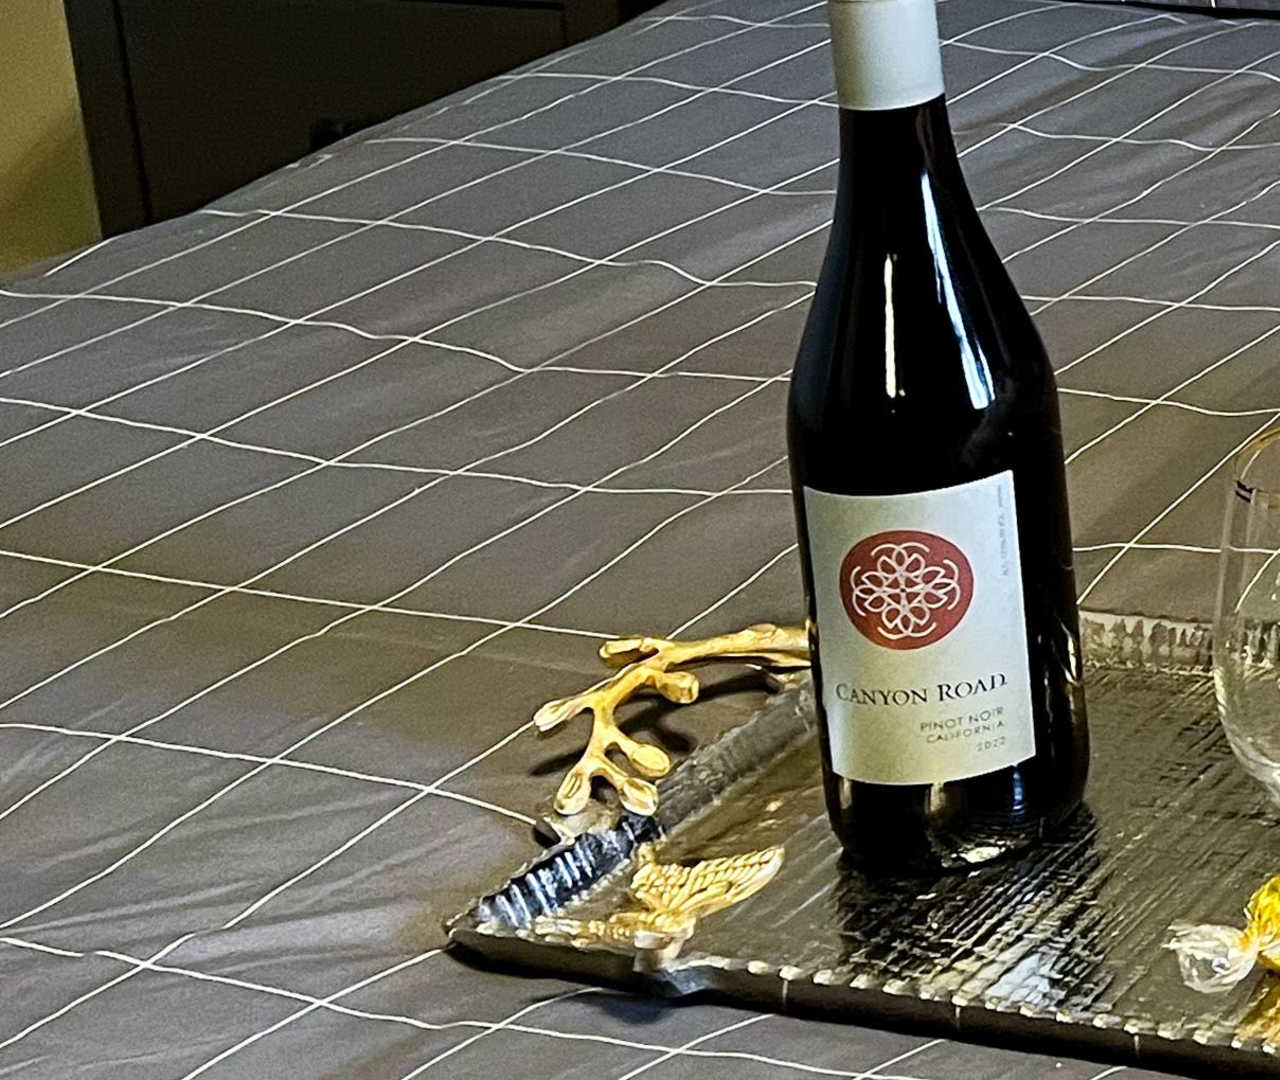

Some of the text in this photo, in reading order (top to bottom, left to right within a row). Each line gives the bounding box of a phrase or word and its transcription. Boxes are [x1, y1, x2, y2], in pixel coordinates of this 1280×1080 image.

[835, 673, 1008, 705] CANYON ROAD
[920, 707, 1004, 731] PINOT NOIR
[926, 721, 1004, 743] CALIFORNIA
